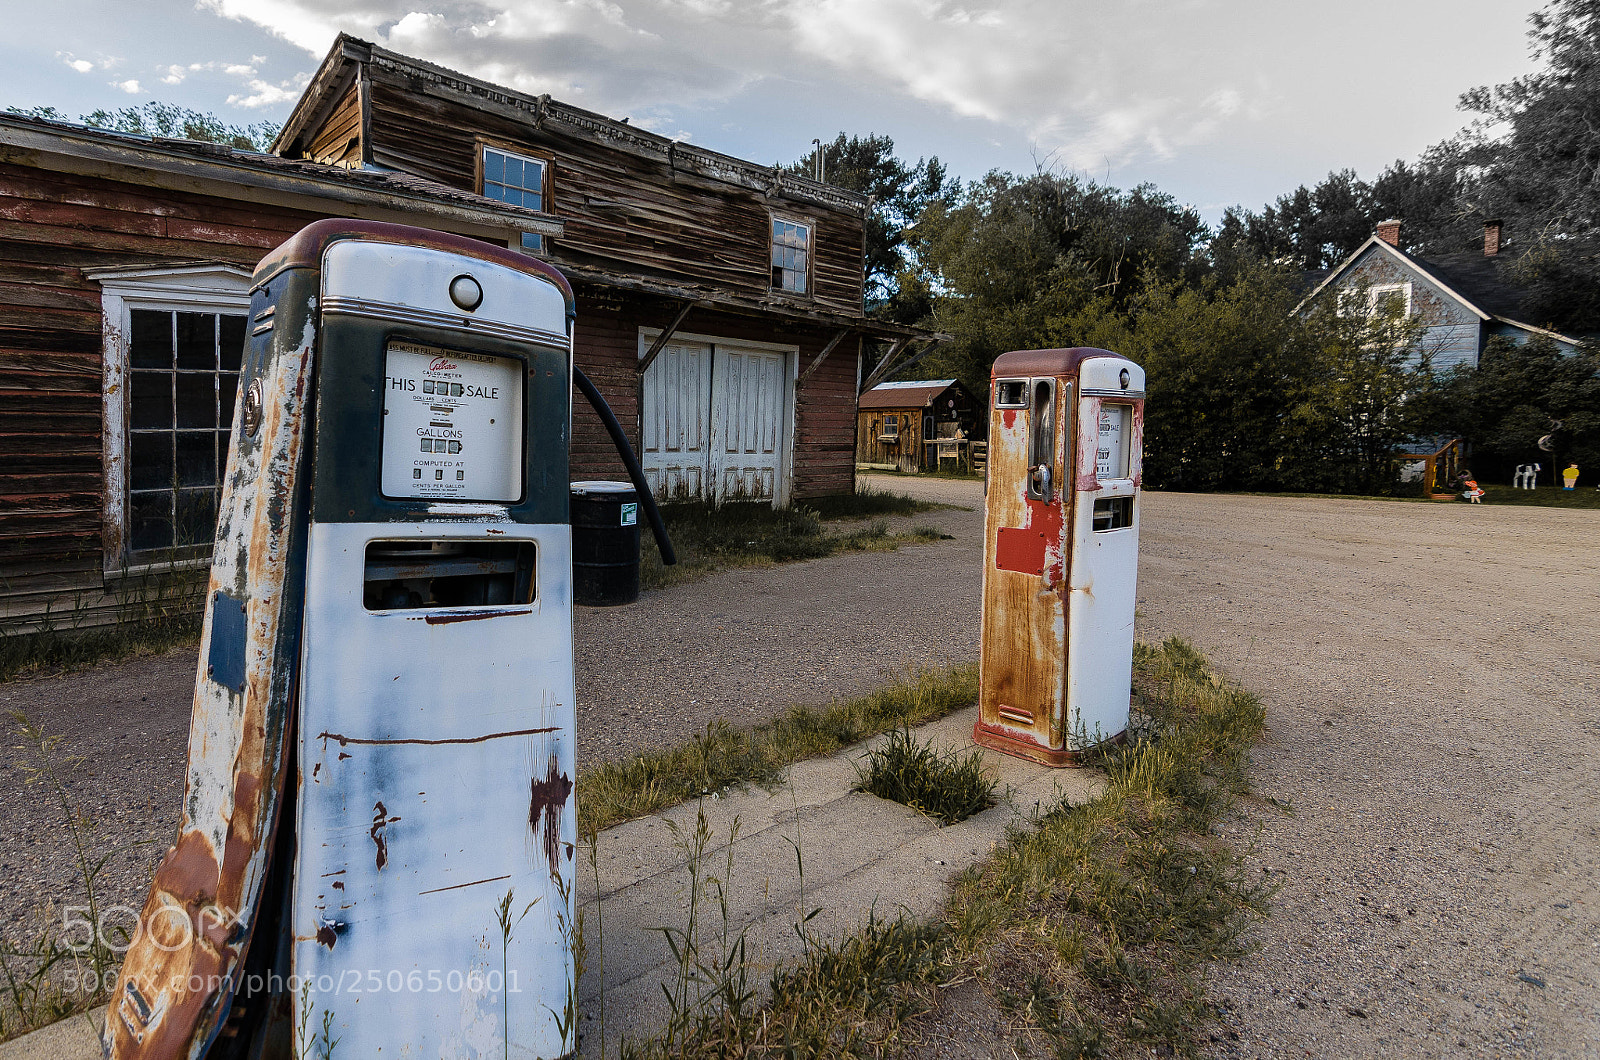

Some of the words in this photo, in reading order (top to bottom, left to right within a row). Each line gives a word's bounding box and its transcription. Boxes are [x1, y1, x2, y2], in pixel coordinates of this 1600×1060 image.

[399, 345, 413, 354] MUST
[466, 386, 499, 399] SALE
[416, 427, 463, 439] GALLONS
